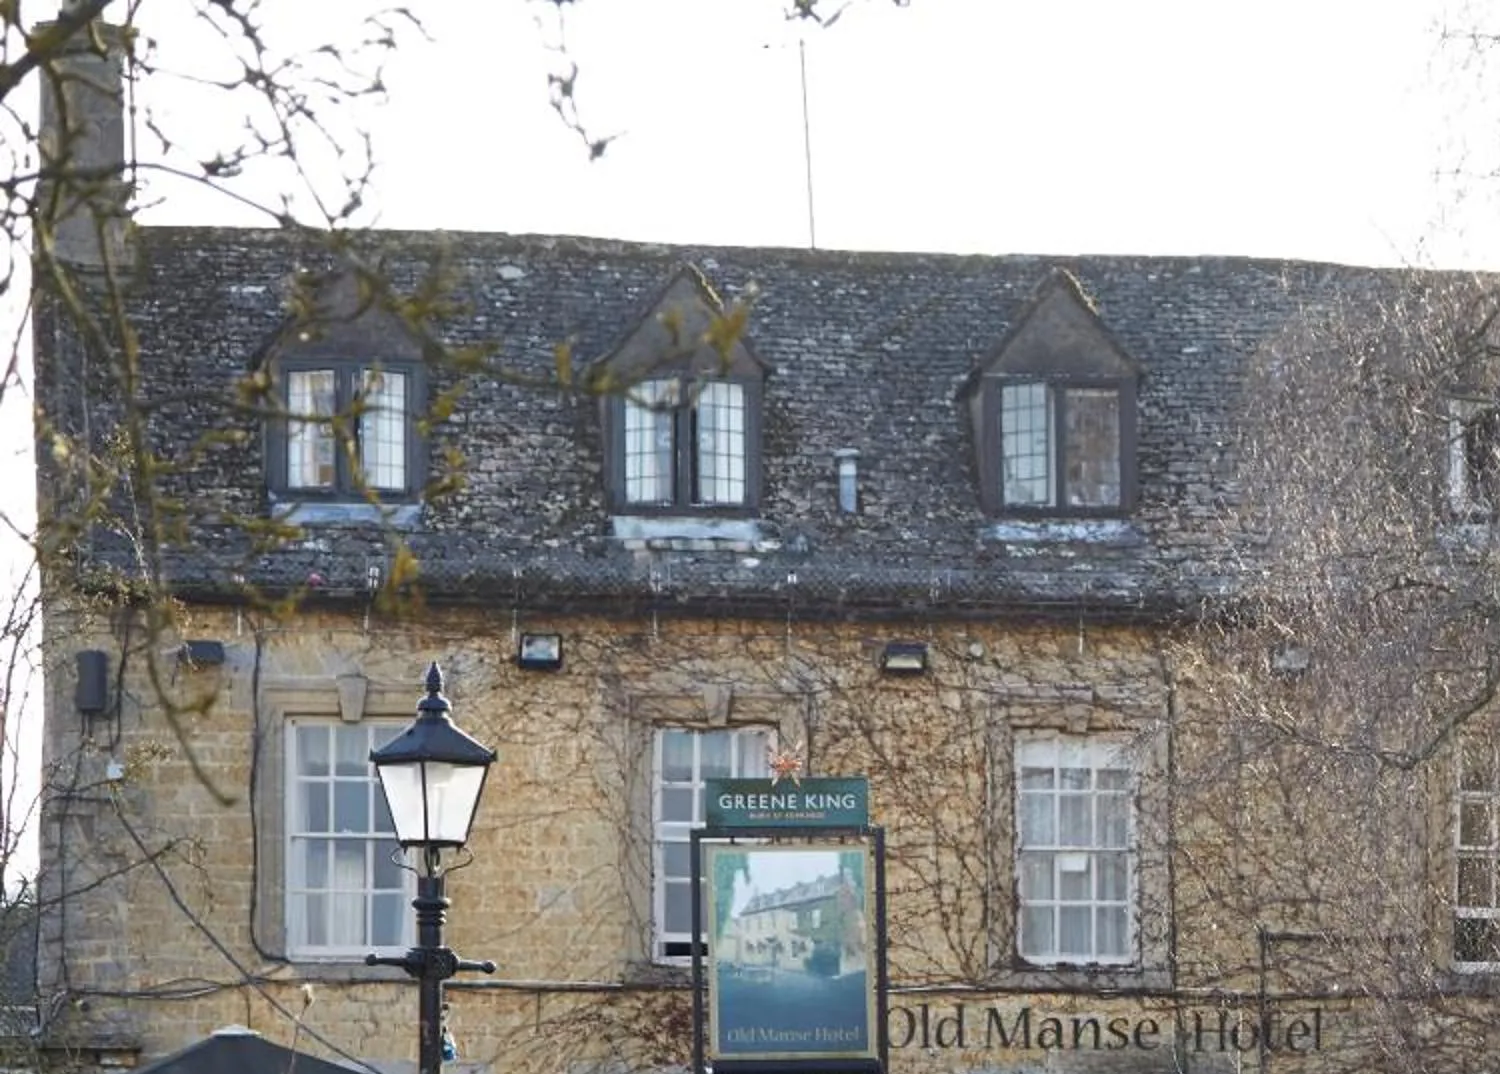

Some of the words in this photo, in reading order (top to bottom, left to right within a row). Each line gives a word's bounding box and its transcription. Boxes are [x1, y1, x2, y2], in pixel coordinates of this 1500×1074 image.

[718, 793, 797, 809] GREENE
[805, 793, 856, 809] KING
[727, 1026, 755, 1042] Old
[757, 1026, 812, 1042] Manse
[815, 1025, 860, 1042] Hotel
[887, 1003, 968, 1049] Old
[984, 1006, 1160, 1051] Manse
[1193, 1007, 1322, 1051] Hotel
